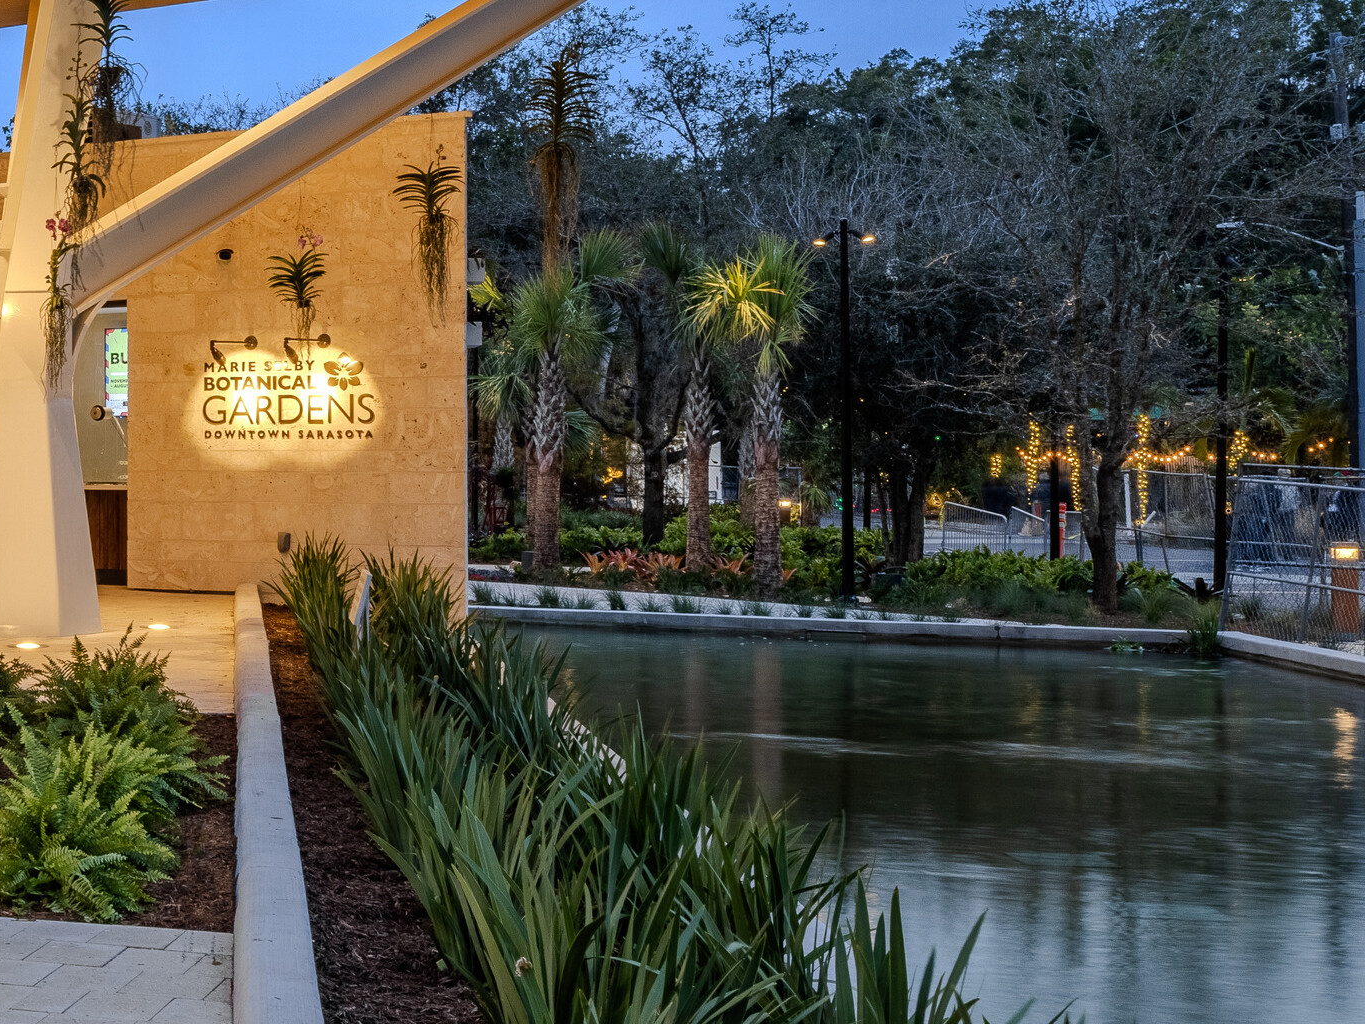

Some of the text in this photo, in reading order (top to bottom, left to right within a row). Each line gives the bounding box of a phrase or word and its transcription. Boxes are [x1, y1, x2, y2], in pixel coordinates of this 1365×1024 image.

[204, 361, 257, 373] MARIE
[203, 375, 317, 392] BOTANICAL
[202, 393, 376, 425] GARDENS
[204, 429, 374, 440] DOWNTOWN SARASOTA
